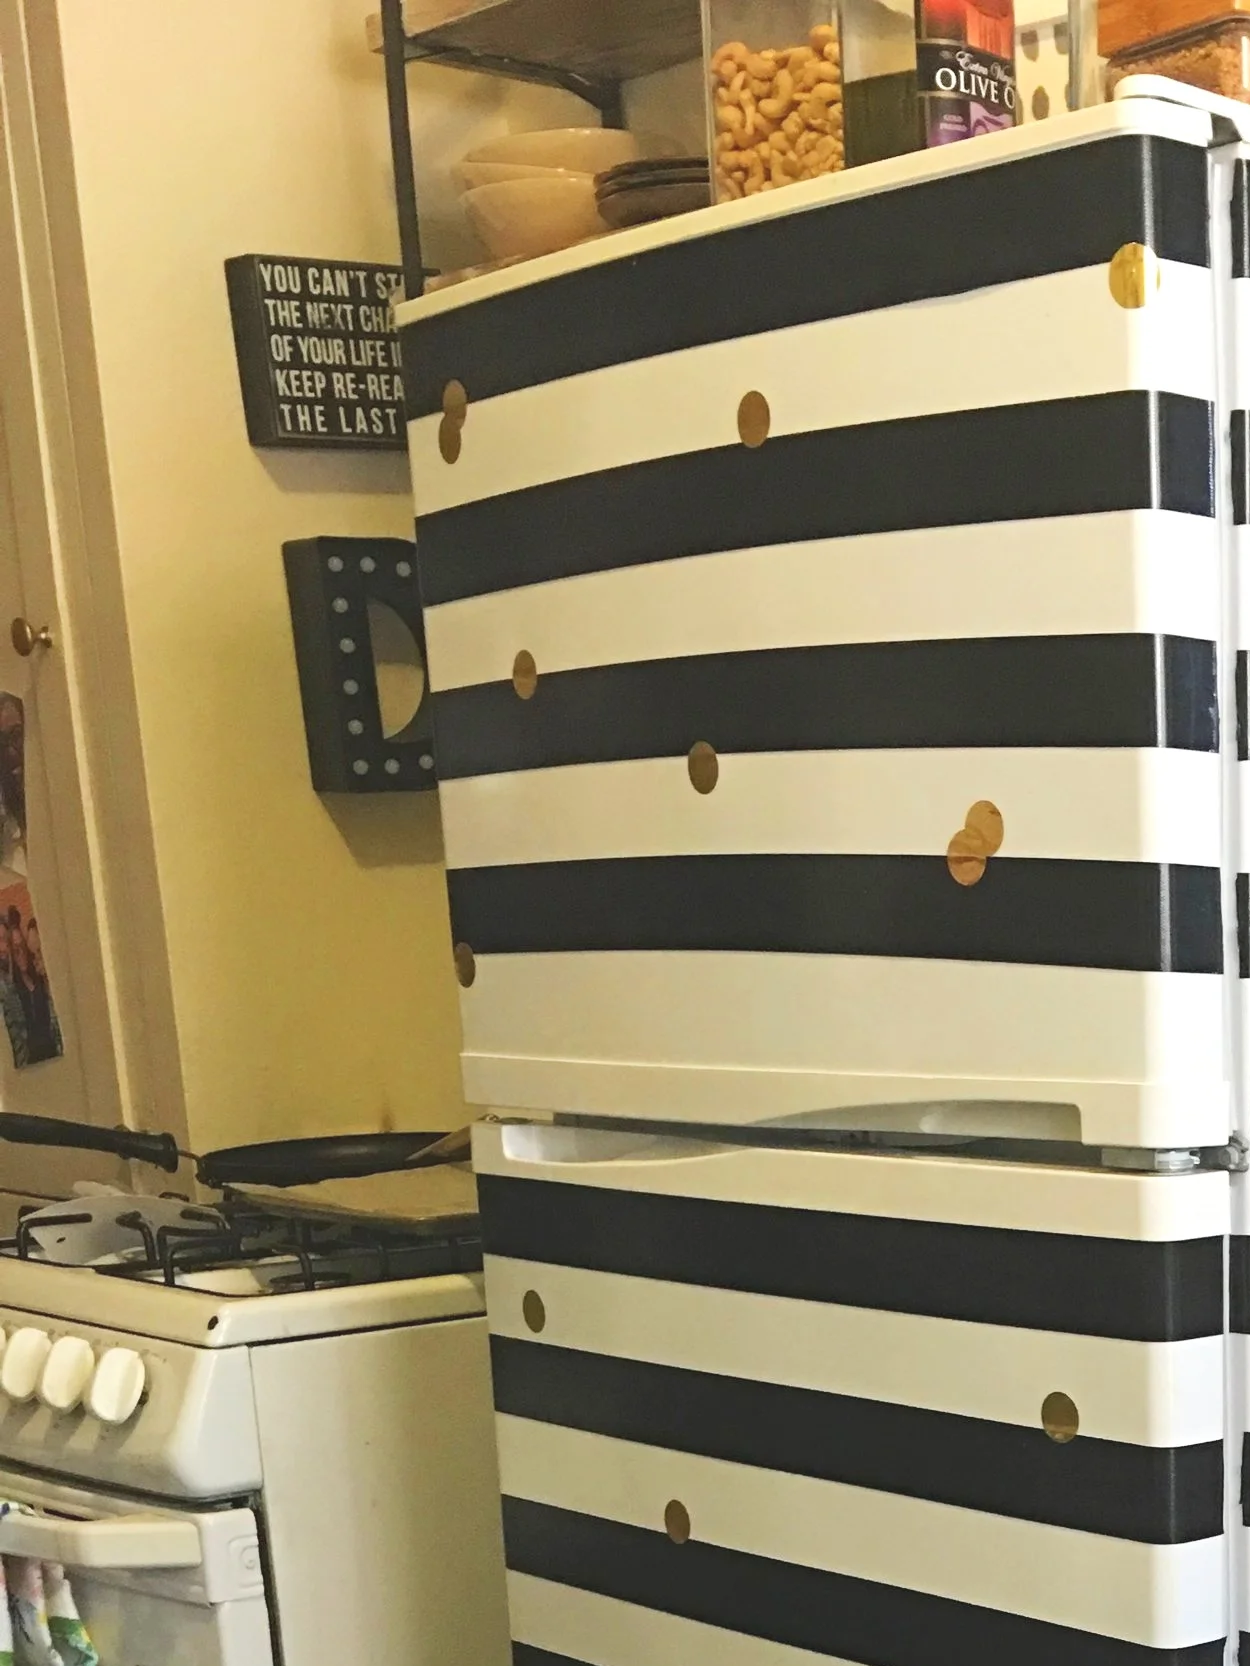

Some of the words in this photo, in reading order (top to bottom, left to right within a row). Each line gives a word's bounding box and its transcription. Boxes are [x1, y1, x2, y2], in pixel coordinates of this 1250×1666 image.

[935, 67, 999, 104] OLIVE
[259, 263, 301, 294] YOU
[307, 267, 367, 298] CAN'T
[264, 299, 303, 328] THE
[306, 302, 354, 331] NEXT
[270, 334, 293, 362] OF
[297, 336, 347, 365] YOUR
[350, 339, 388, 367] LIFE
[275, 369, 326, 398] KEEP
[280, 403, 328, 433] THE
[339, 406, 397, 434] LAST
